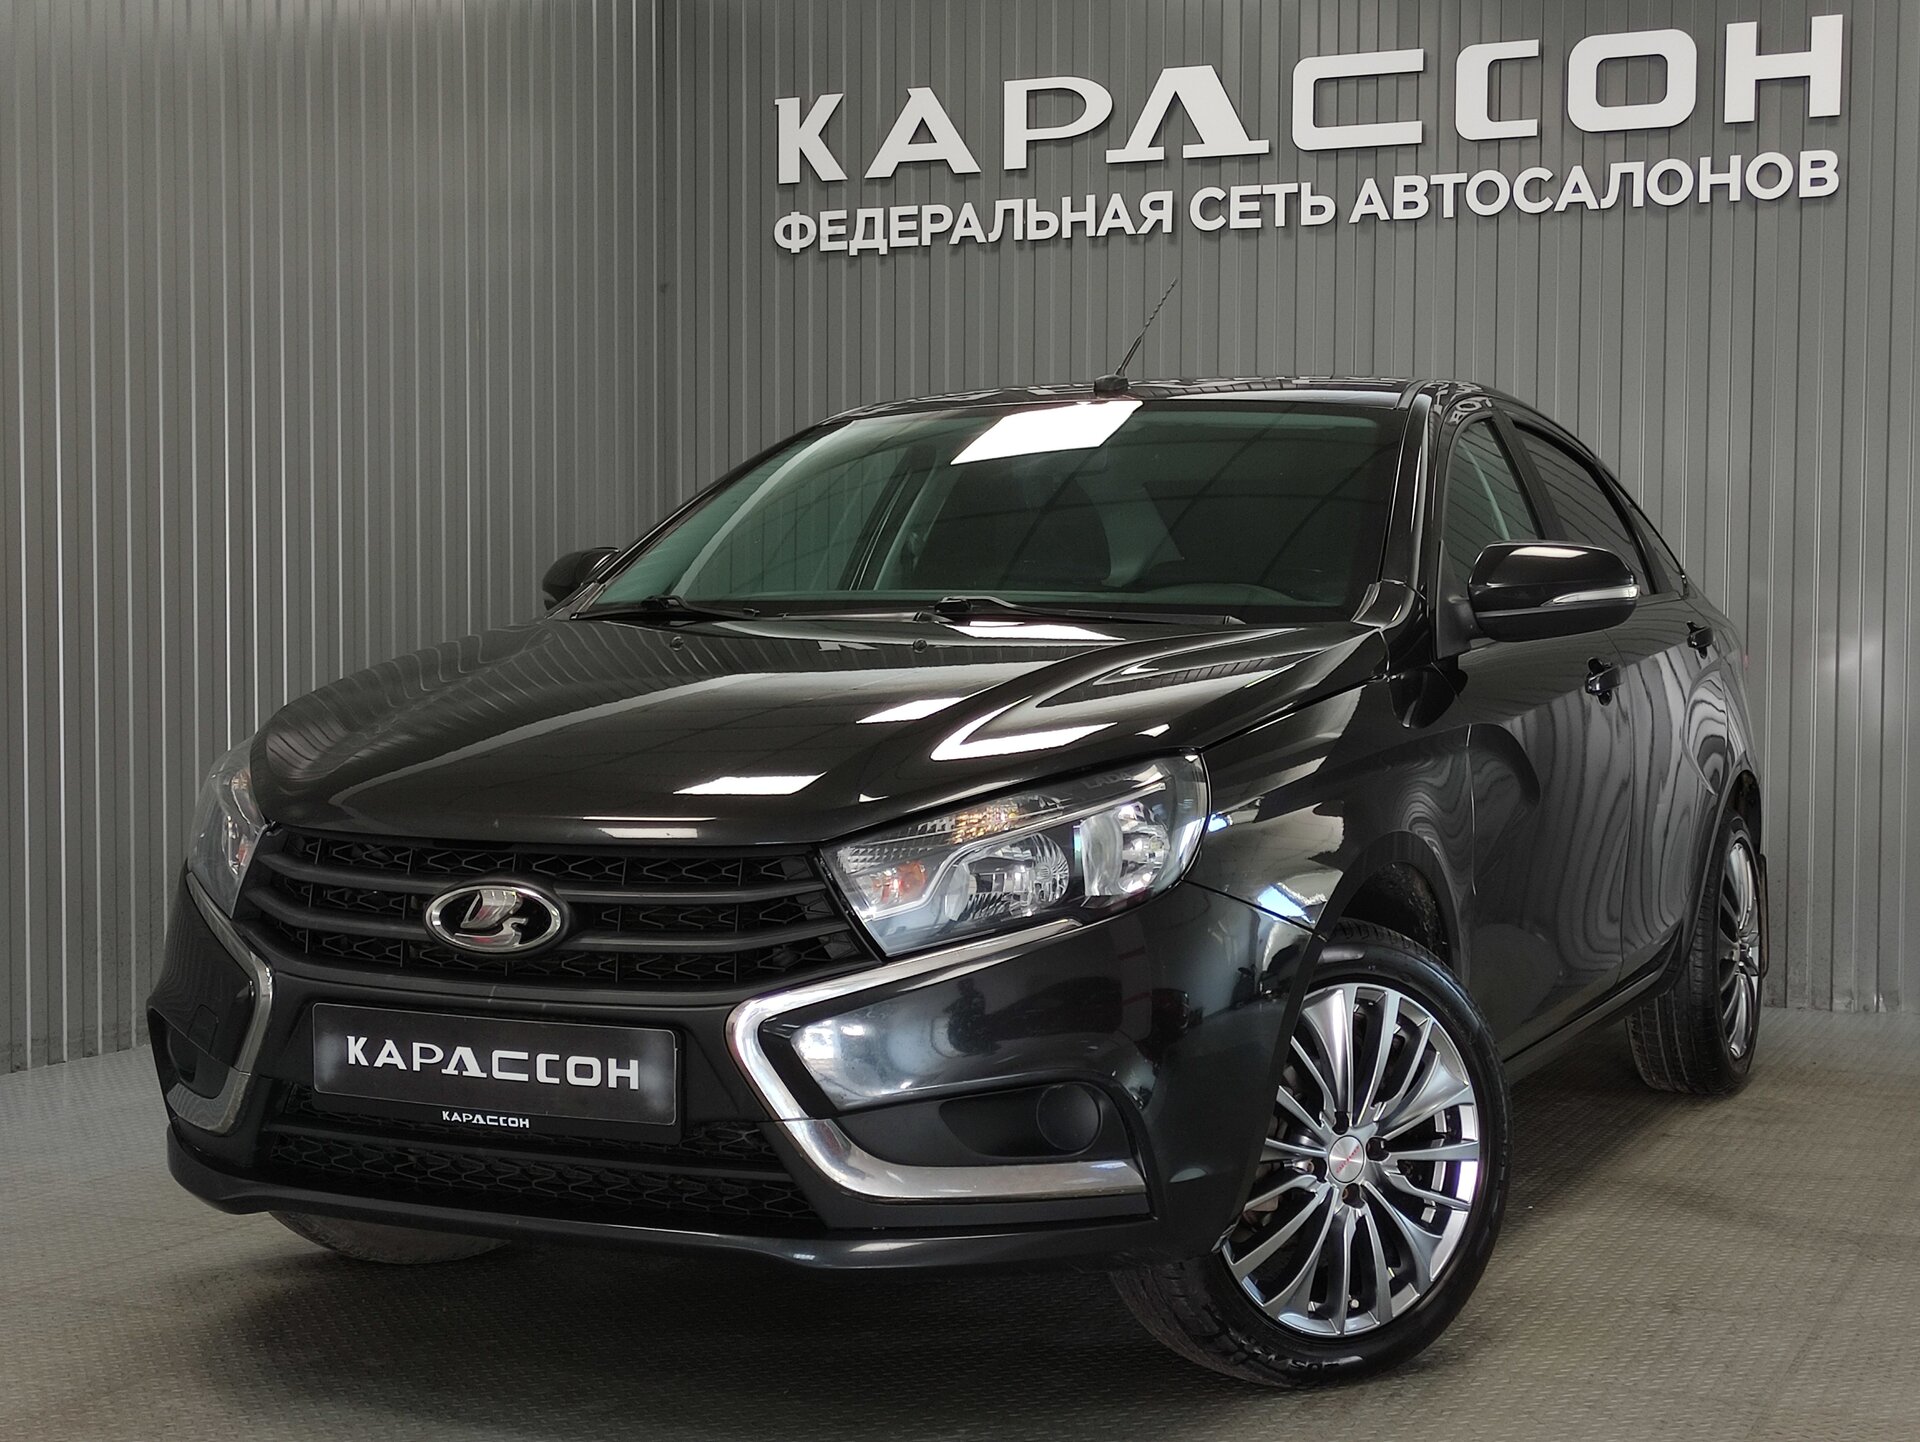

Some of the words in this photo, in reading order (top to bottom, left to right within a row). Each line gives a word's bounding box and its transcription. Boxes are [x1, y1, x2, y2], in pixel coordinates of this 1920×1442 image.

[773, 190, 1173, 256] ФЕДЕРАЛЬНАЯ
[1189, 182, 1336, 231] СЕТЬ
[1348, 149, 1840, 224] АВТОСАЛОНОВ
